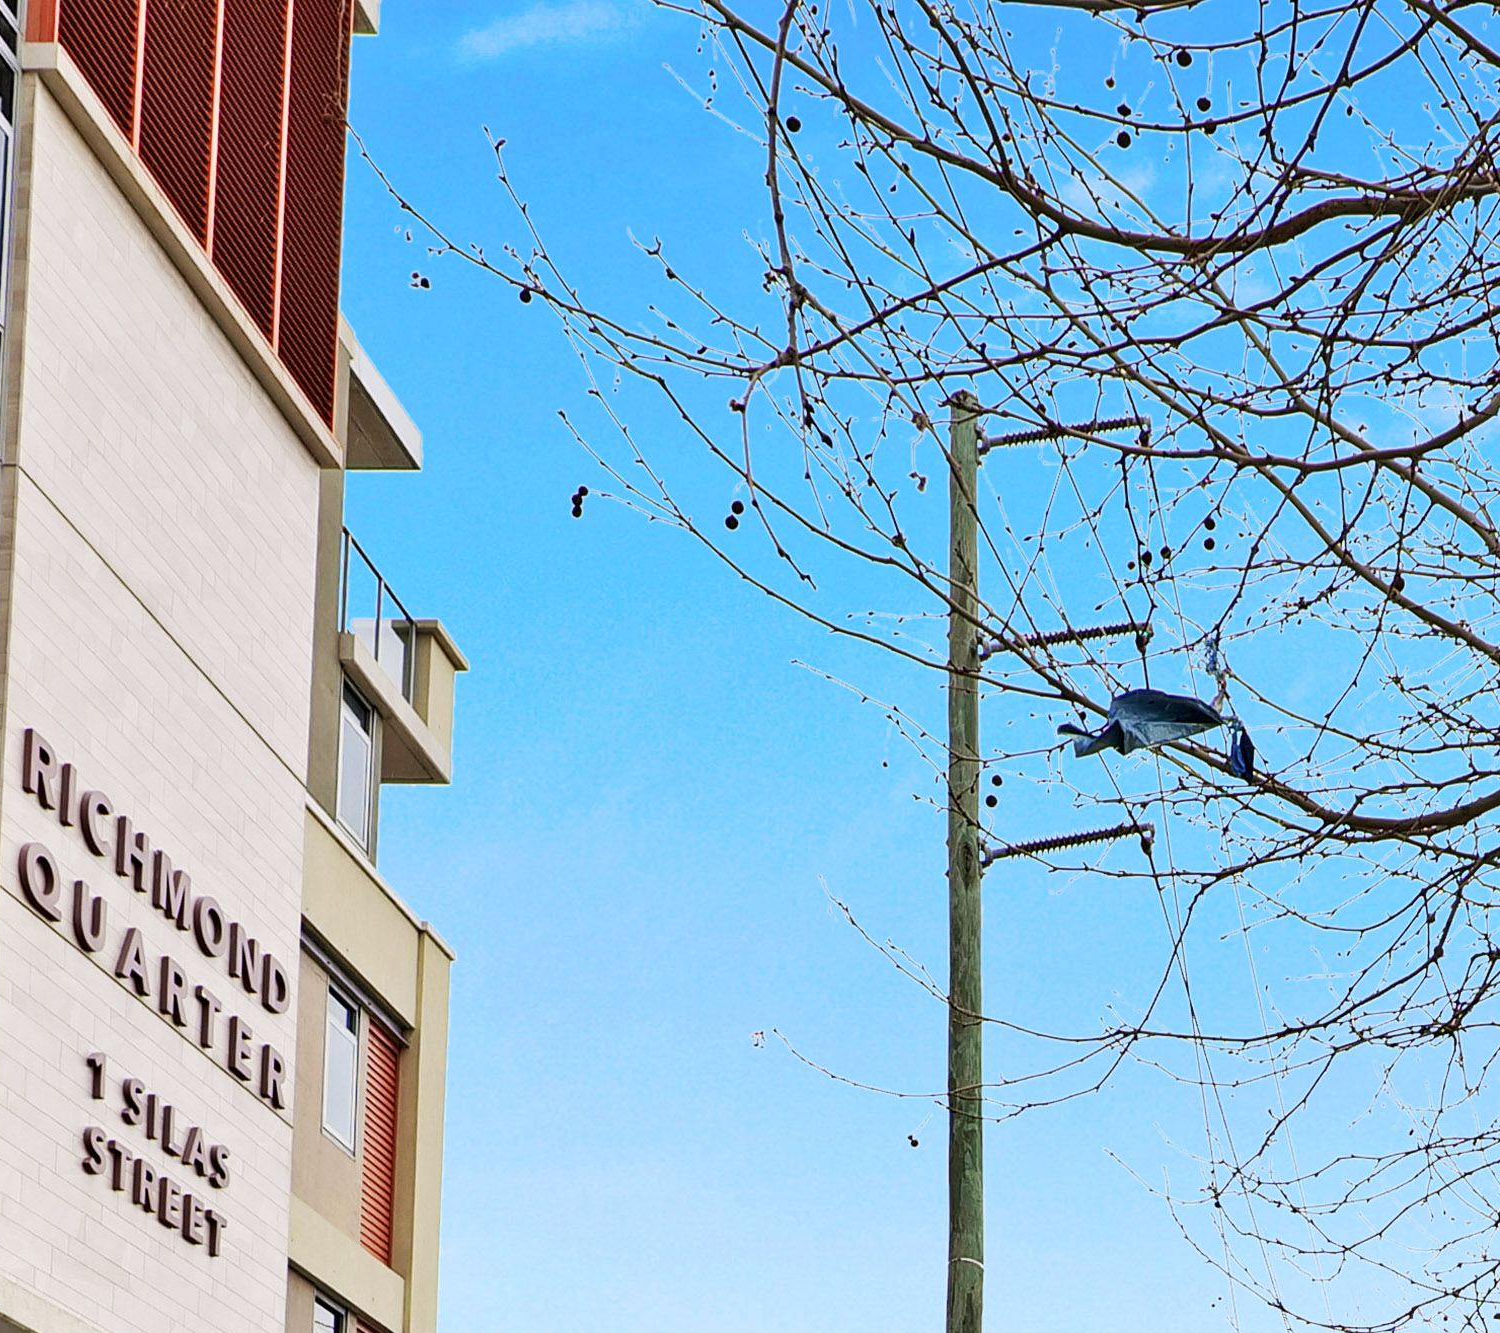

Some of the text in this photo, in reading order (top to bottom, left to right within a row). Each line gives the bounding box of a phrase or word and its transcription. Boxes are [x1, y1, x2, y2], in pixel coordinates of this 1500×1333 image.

[23, 728, 290, 1013] RICHMOND
[19, 842, 286, 1108] QUARTER
[82, 1126, 227, 1257] STREET
[87, 1052, 230, 1189] 1 SILAS
